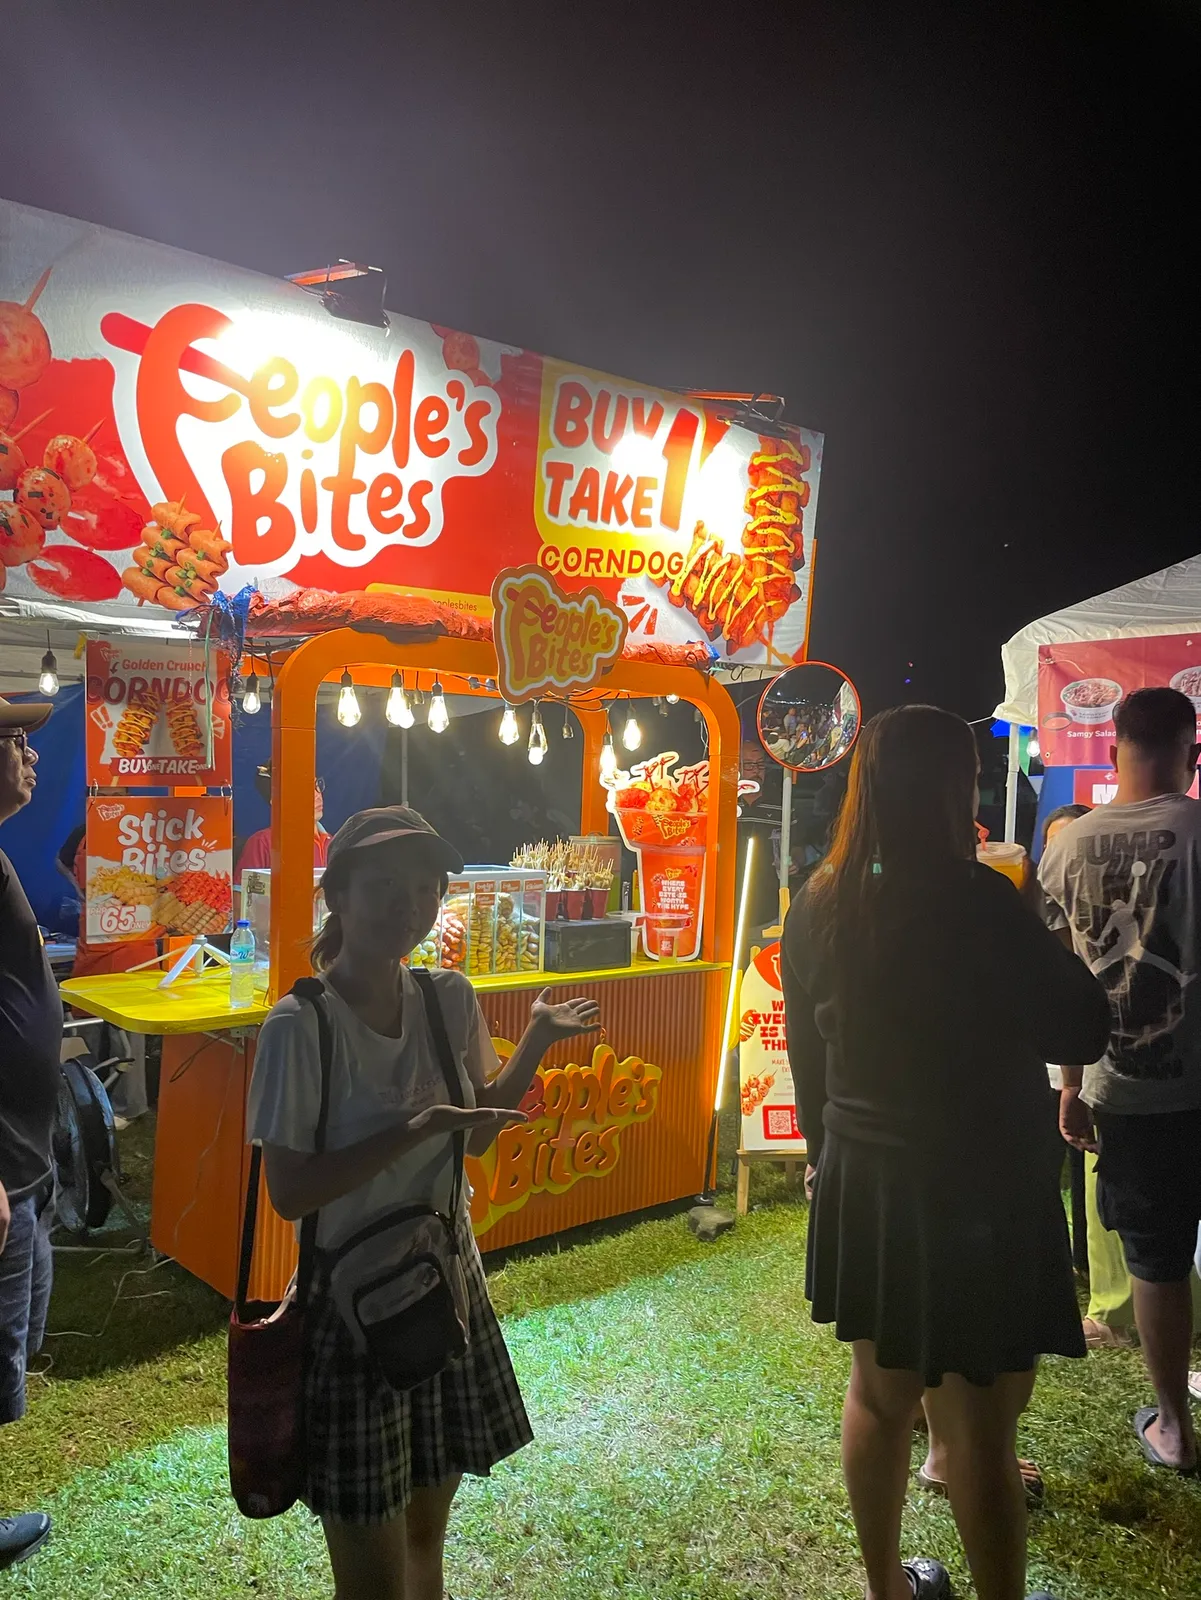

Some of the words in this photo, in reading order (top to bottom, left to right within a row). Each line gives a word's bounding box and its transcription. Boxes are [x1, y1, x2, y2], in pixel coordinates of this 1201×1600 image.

[101, 303, 492, 545] People's
[554, 382, 664, 455] BUY
[546, 461, 658, 528] TAKE
[660, 408, 699, 533] 1
[221, 440, 433, 565] Bites
[541, 545, 683, 575] CORNDOG
[507, 586, 618, 681] People's
[122, 659, 164, 671] Golden
[527, 634, 591, 678] Bites
[118, 758, 151, 774] BUY
[159, 760, 198, 774] TAKE
[118, 809, 204, 846] Stick
[122, 844, 206, 876] Bites
[101, 905, 136, 933] 65
[760, 1026, 778, 1037] IS
[489, 1125, 620, 1206] Bites
